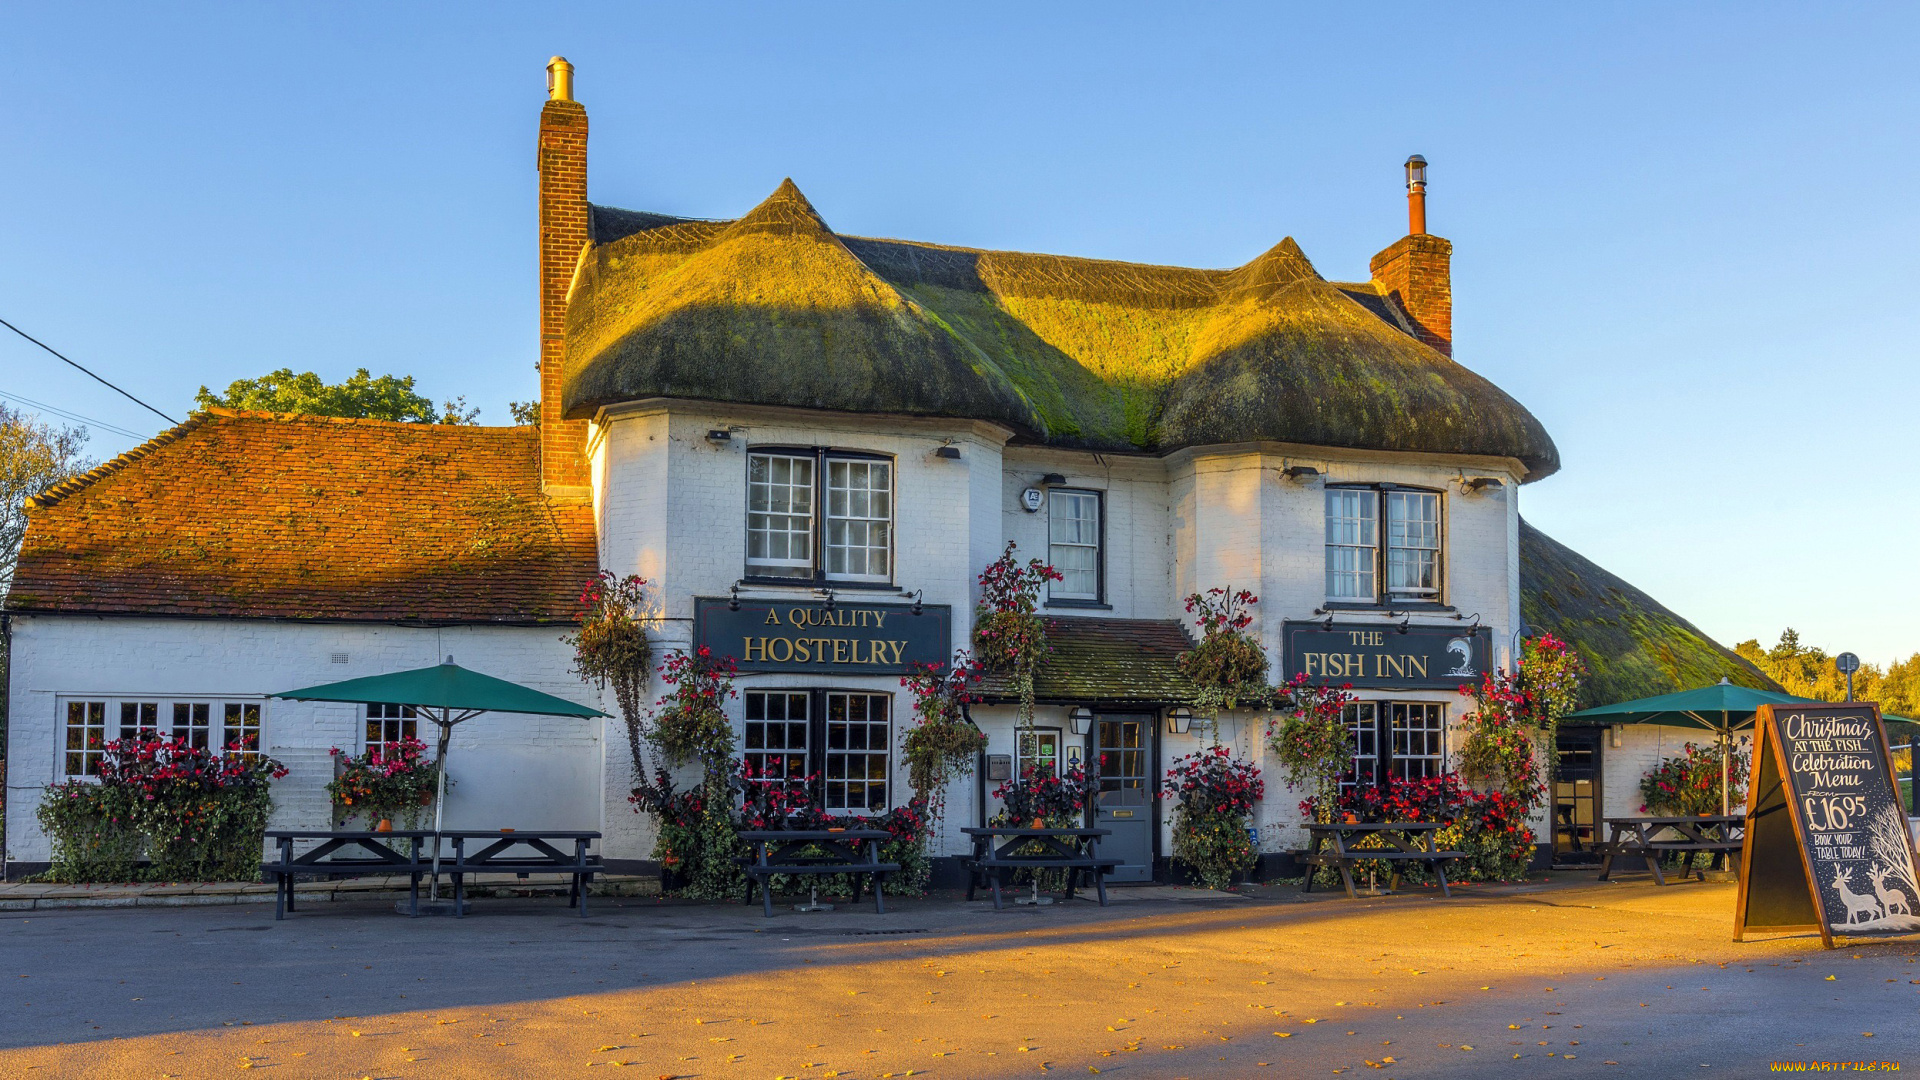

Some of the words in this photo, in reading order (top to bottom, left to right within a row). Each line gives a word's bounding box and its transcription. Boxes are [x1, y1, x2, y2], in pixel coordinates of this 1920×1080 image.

[764, 608, 782, 625] A
[788, 608, 888, 630] QUALITY
[1349, 631, 1384, 646] THE
[742, 636, 909, 665] HOSTELRY
[1303, 652, 1365, 678] FISH
[1375, 654, 1429, 679] INN
[1787, 714, 1874, 741] Christmas
[1794, 741, 1807, 752] AT
[1809, 740, 1833, 752] THE
[1792, 753, 1874, 773] Celebration
[1809, 771, 1863, 789] Menu
[1814, 834, 1833, 846] BOOK
[1833, 834, 1853, 845] YOUR
[1815, 846, 1840, 860] TABLE
[1840, 846, 1866, 859] TODAY!
